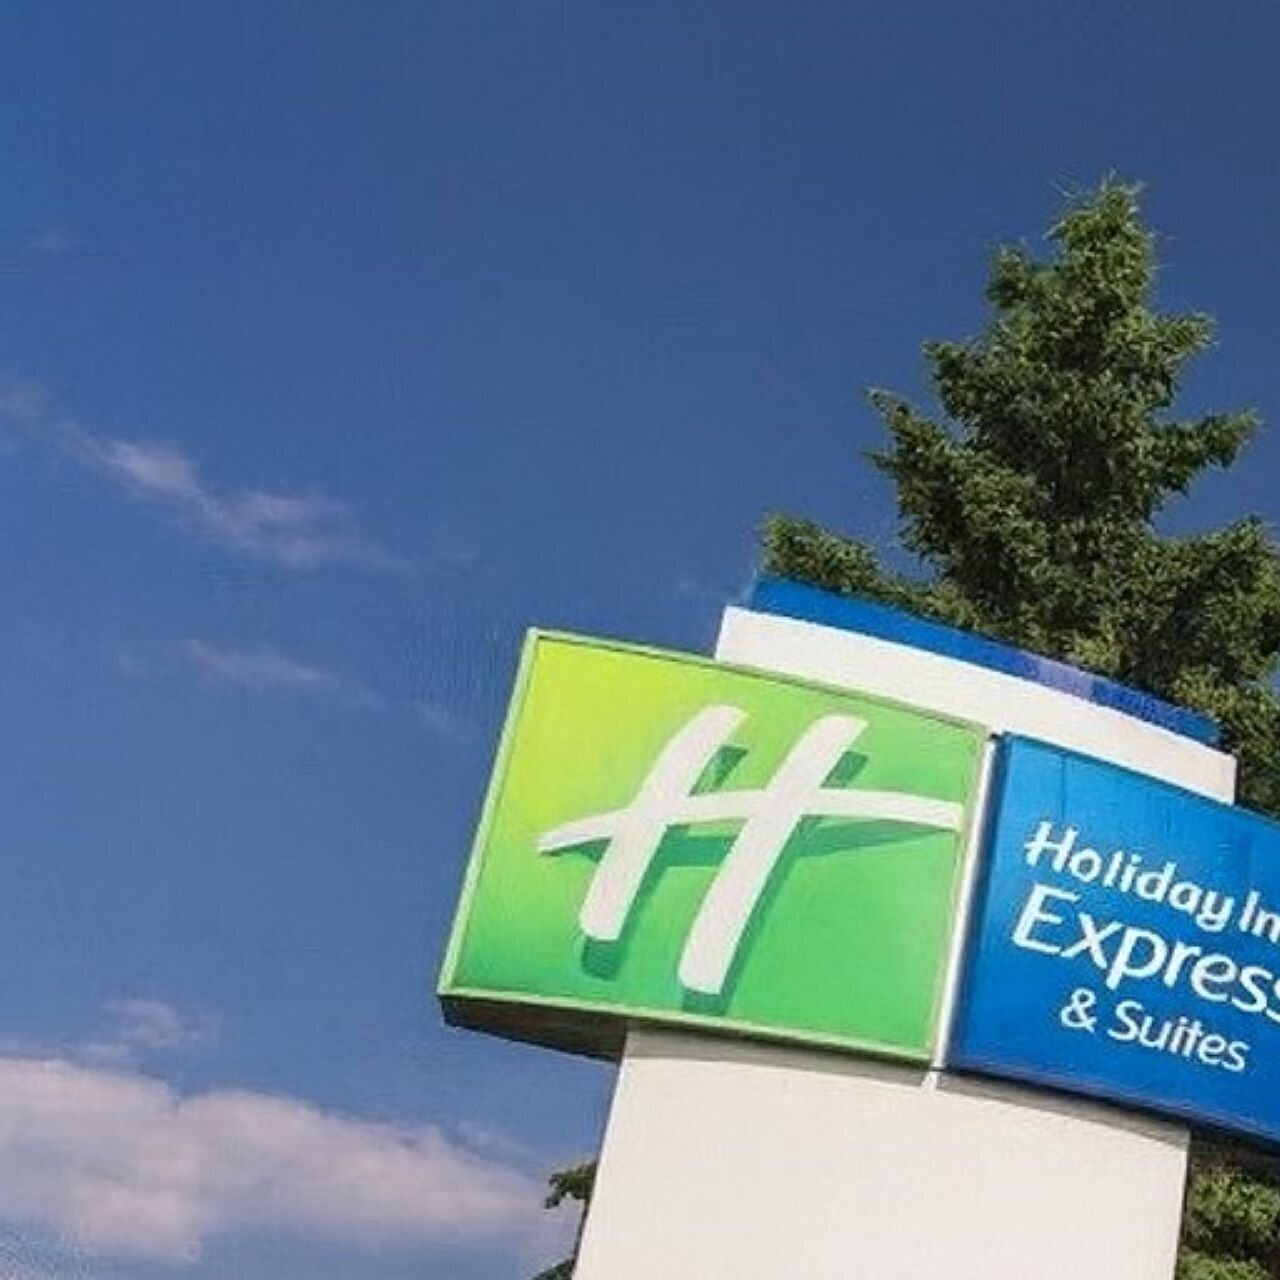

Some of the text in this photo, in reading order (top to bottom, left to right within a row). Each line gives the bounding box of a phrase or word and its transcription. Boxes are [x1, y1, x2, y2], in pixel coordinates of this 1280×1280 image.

[1023, 821, 1235, 932] Holiday
[1061, 988, 1249, 1071] & Suites
